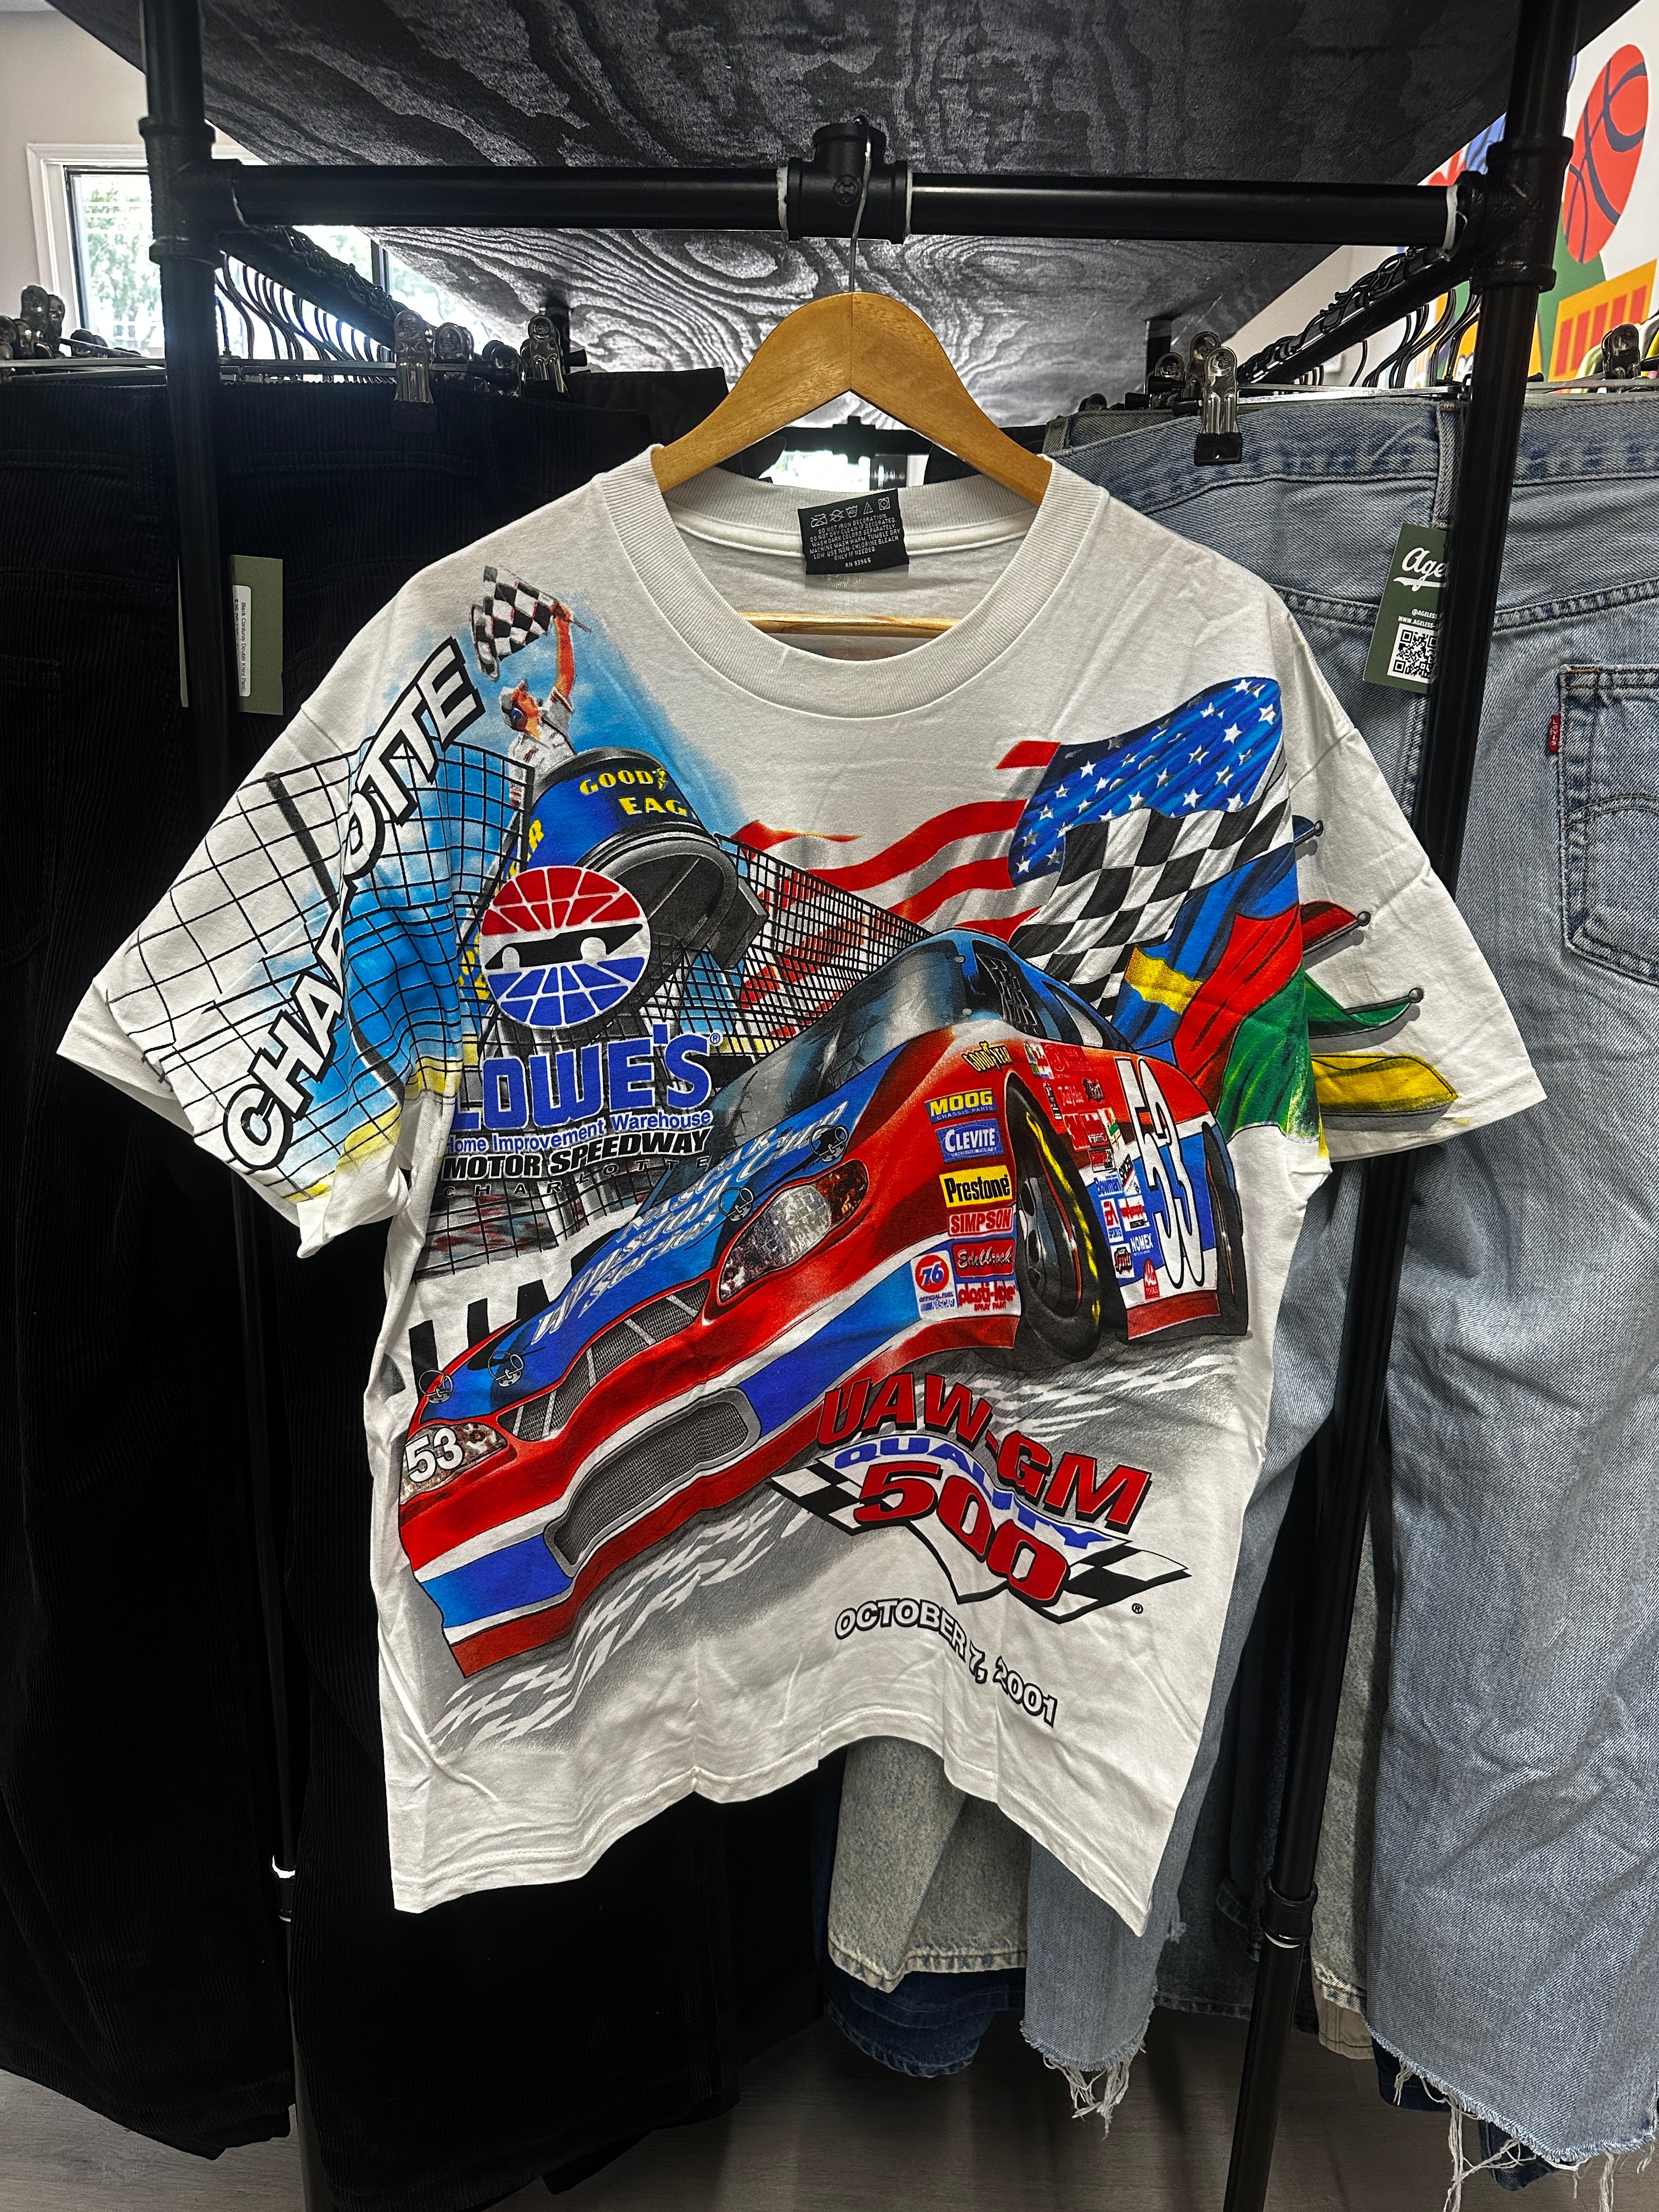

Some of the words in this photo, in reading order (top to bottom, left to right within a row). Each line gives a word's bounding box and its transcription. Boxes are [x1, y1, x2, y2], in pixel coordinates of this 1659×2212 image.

[841, 526, 858, 535] CLEAN
[865, 517, 896, 528] DECORATED.
[853, 513, 887, 526] DECORATION.
[810, 544, 833, 554] MACHINE
[834, 539, 849, 548] WASH
[867, 531, 889, 540] TUMBLE
[812, 539, 827, 548] WASH
[828, 535, 842, 544] DARK
[842, 531, 862, 540] COLORS
[864, 523, 896, 535] SEPARATELY.
[838, 539, 878, 554] NON-CHLORINE
[878, 535, 899, 545] BLEACH
[854, 557, 871, 566] 93965
[618, 796, 698, 821] EAG
[222, 636, 486, 1172] CHAROTTE
[930, 1091, 992, 1116] MOOG
[937, 1109, 969, 1120] CHASSIS
[493, 1120, 604, 1153] Improvement
[611, 1110, 713, 1131] Warehouse
[945, 1128, 995, 1152] CLEVITE
[443, 1154, 543, 1180] MOTOR
[550, 1127, 713, 1174] SPEEDWAY
[1115, 1057, 1205, 1289] 53
[944, 1174, 1011, 1203] Prestone
[951, 1209, 1012, 1233] SIMPSON
[1130, 1233, 1154, 1252] NOMEX
[958, 1245, 1012, 1269] Edelbrock
[919, 1261, 944, 1286] 76
[919, 1294, 941, 1302] OFFICIAL
[974, 1302, 990, 1311] SPRAY
[992, 1301, 1007, 1310] PAINT
[405, 1427, 464, 1483] 53
[815, 1372, 1153, 1534] UAW-GM
[834, 1436, 1113, 1549] QUALITY
[854, 1460, 1072, 1608] 500
[834, 1597, 969, 1661] OCTOBER
[968, 1650, 989, 1683] 7,
[992, 1655, 1059, 1728] 2001
